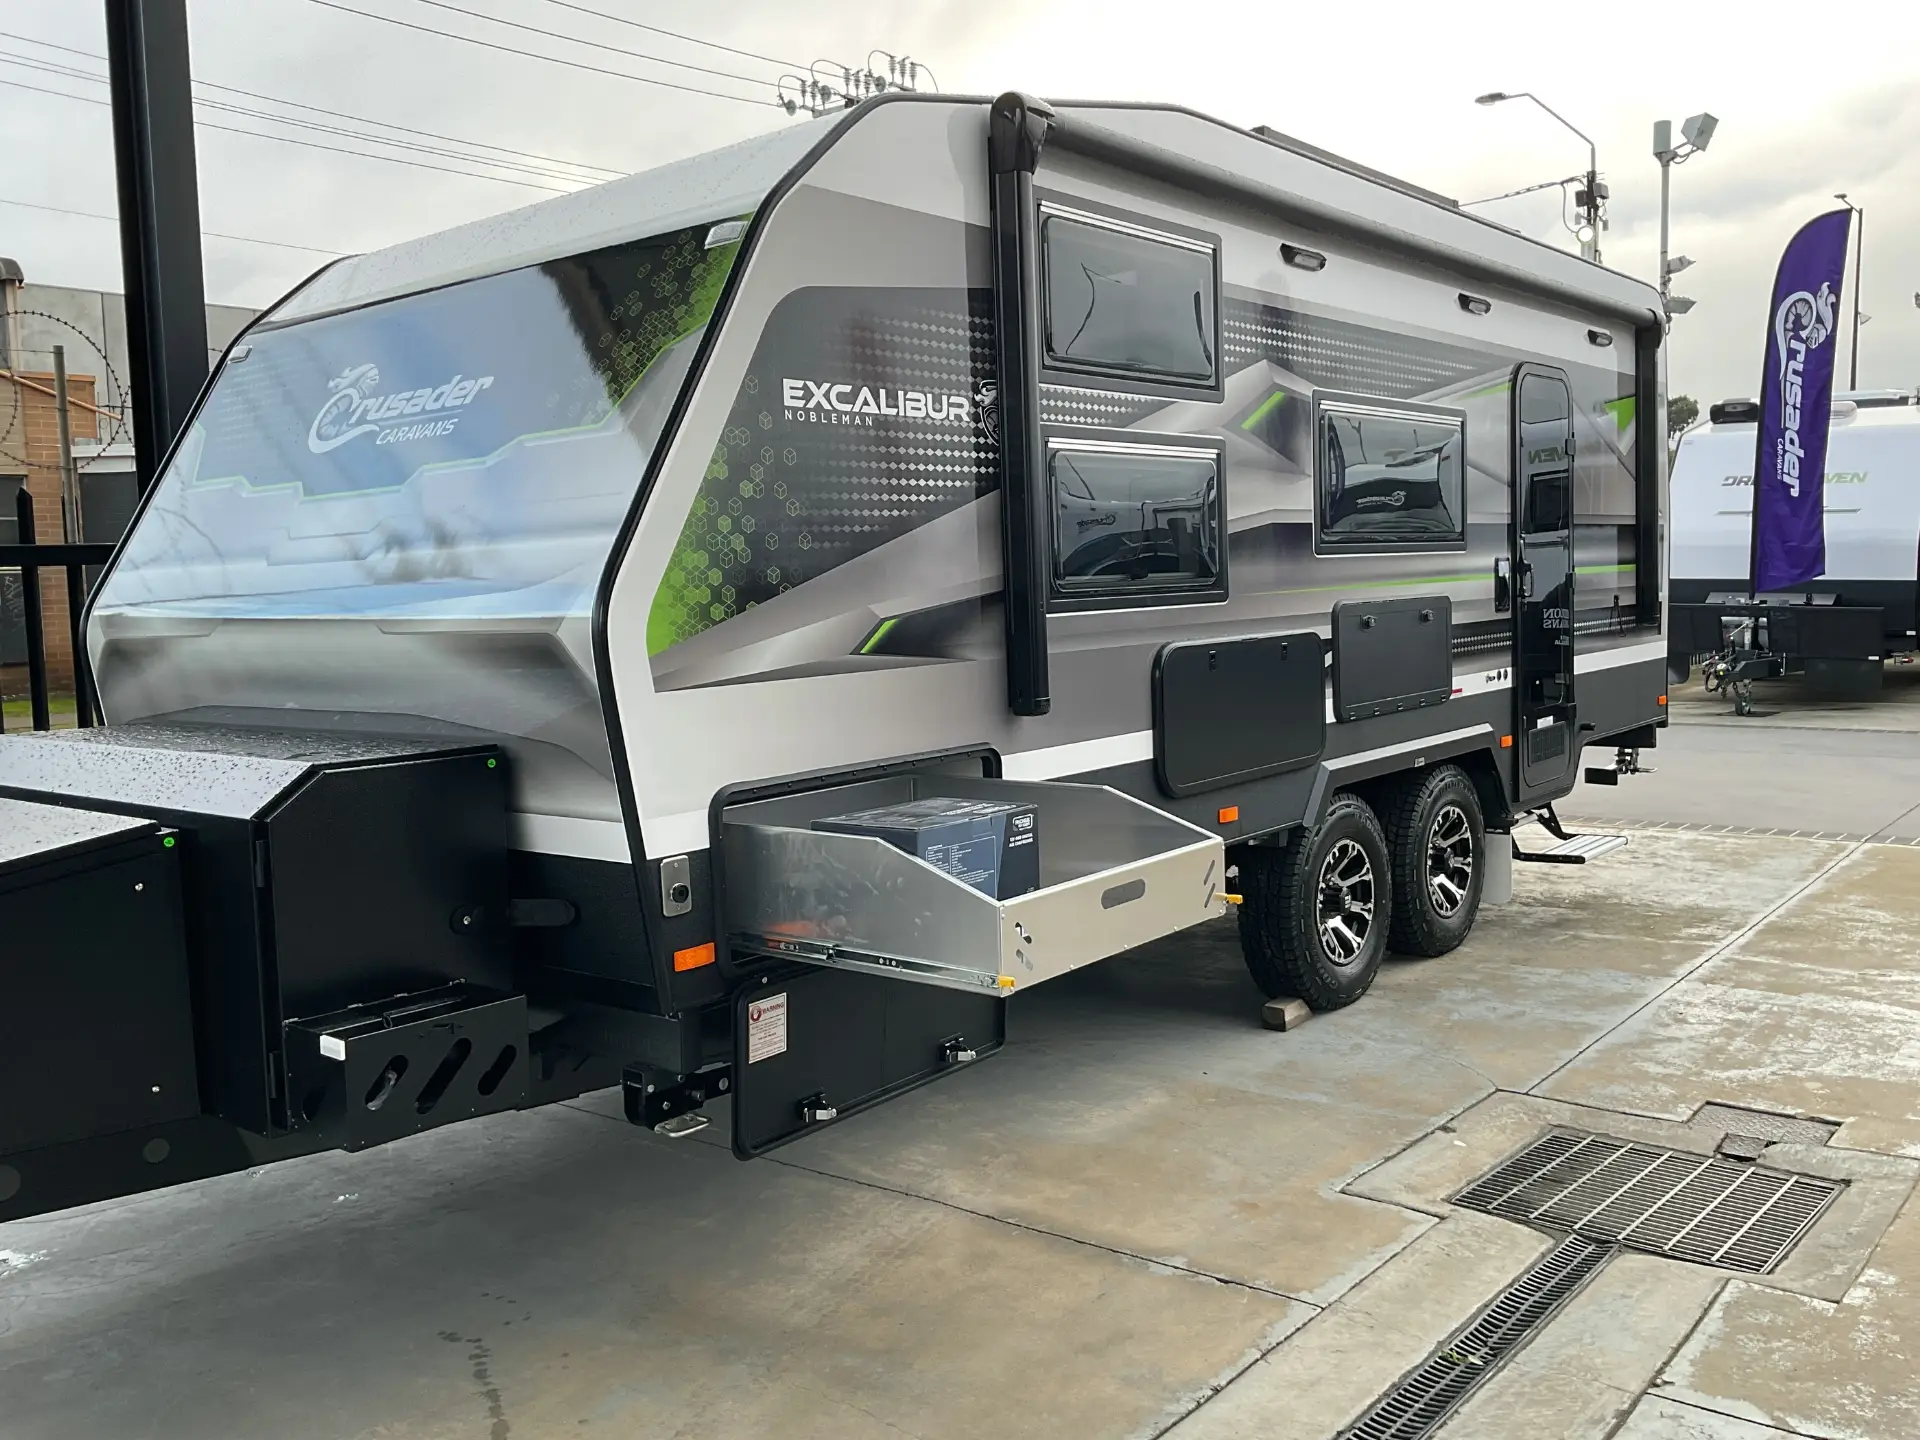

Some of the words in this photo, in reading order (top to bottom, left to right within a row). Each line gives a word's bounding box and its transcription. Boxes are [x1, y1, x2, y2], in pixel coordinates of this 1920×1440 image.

[308, 374, 495, 454] Crusader
[782, 378, 970, 422] EXCALIBUR
[1776, 291, 1816, 497] Crusader
[376, 418, 459, 445] CARAVANS
[784, 409, 873, 426] NOBLEMAN
[1776, 438, 1784, 481] CARAVANS
[762, 1002, 784, 1014] WARNING
